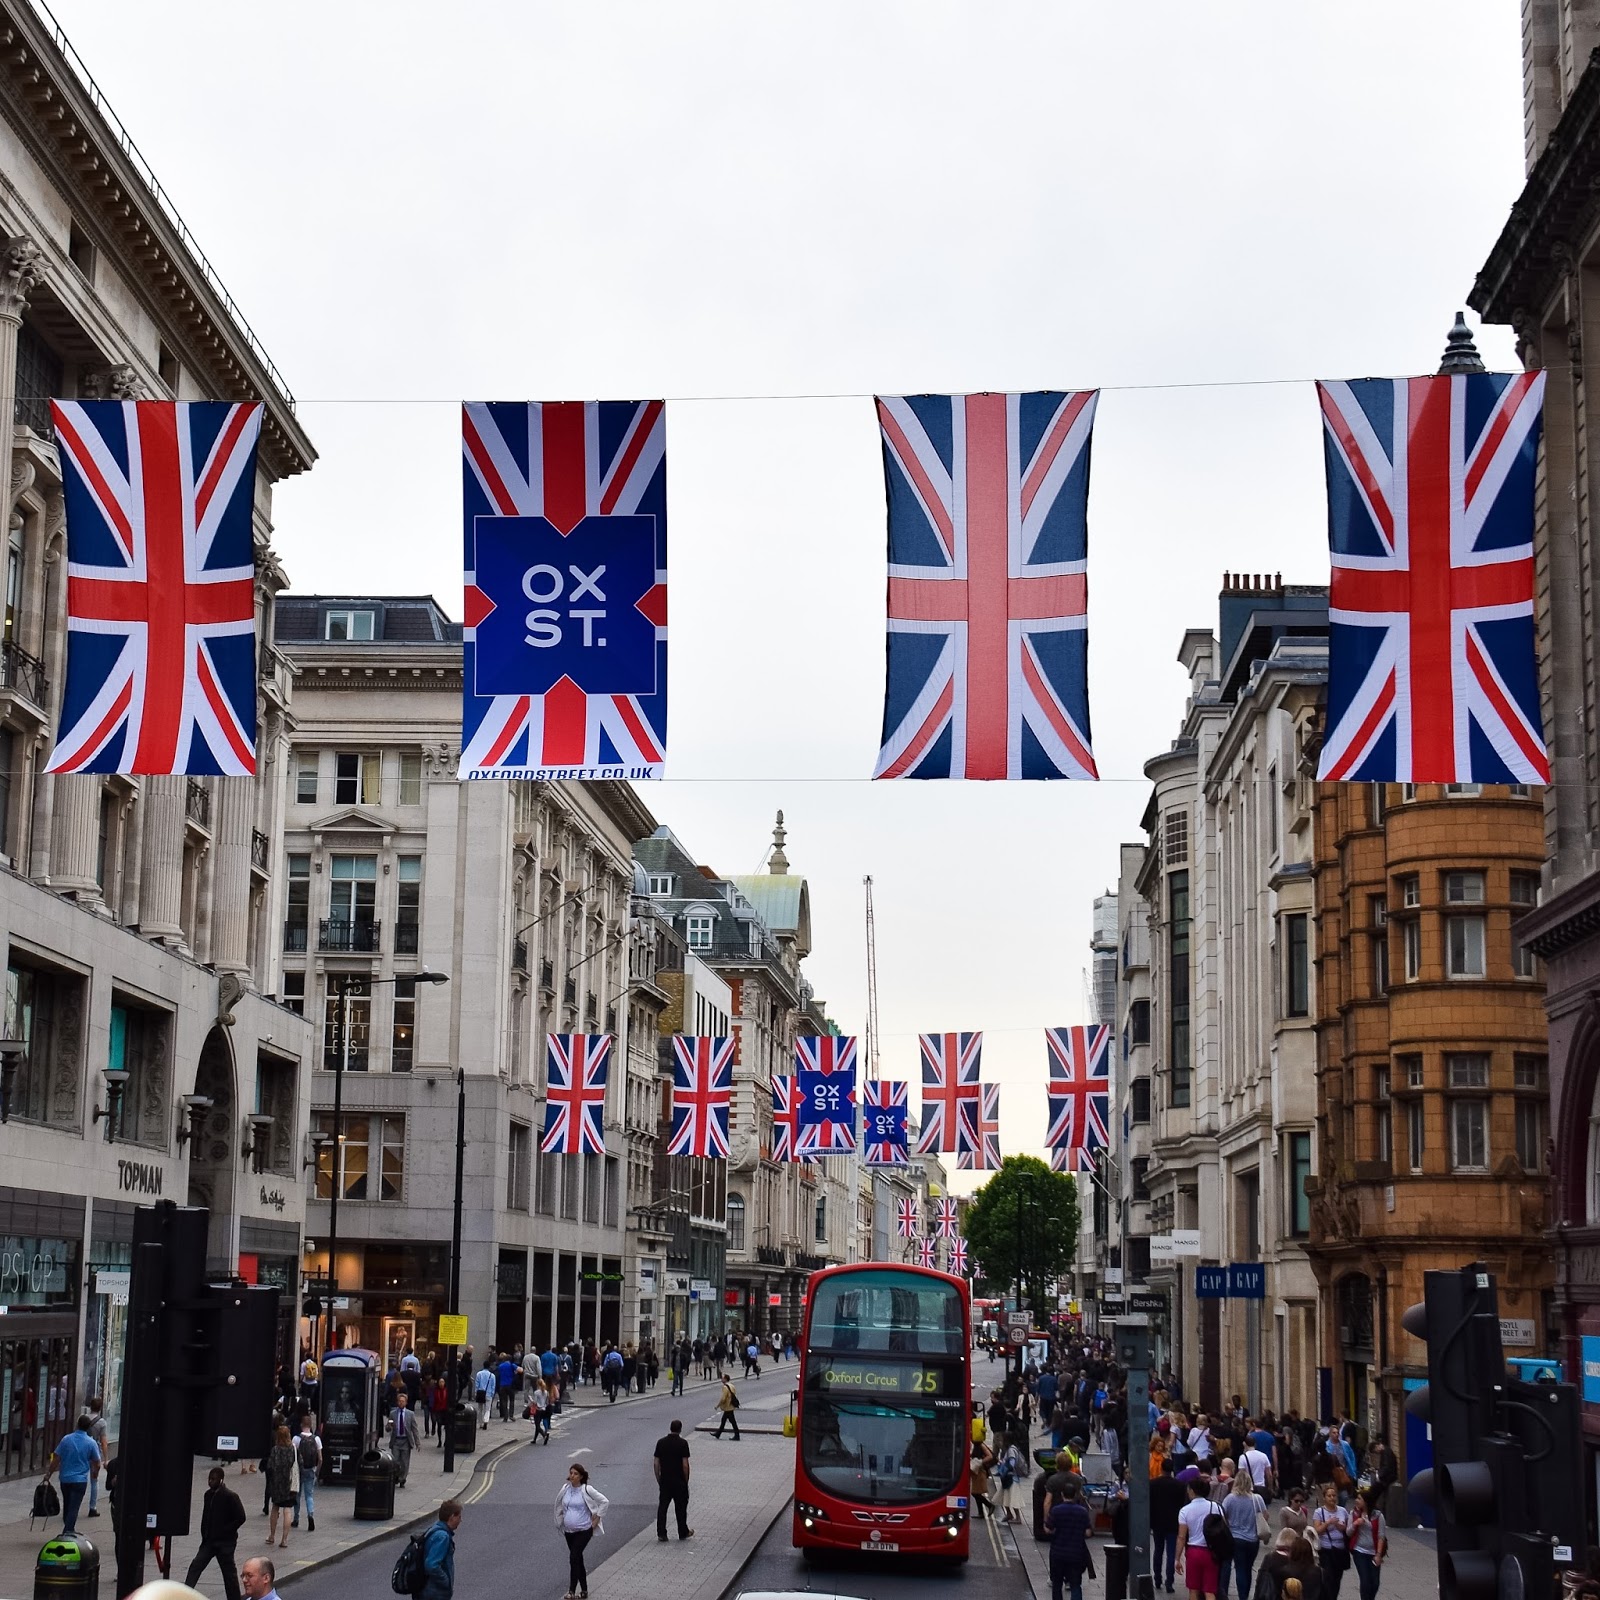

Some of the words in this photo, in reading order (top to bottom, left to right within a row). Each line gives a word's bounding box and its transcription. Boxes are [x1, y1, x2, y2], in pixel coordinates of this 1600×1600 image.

[522, 564, 606, 603] OX
[524, 609, 607, 648] ST.
[468, 767, 654, 780] OXFORDSTREET.CO.UK
[813, 1084, 840, 1097] OX
[814, 1098, 840, 1111] ST.
[876, 1115, 895, 1125] OX
[118, 1159, 163, 1196] TOPMAN
[0, 1252, 53, 1293] PSHOP
[1201, 1275, 1221, 1290] GAP
[1236, 1272, 1259, 1289] GAP
[1133, 1299, 1164, 1308] Bershka
[725, 1309, 738, 1318] OME
[1500, 1321, 1518, 1329] RGYLL
[825, 1370, 862, 1384] Oxford
[865, 1373, 898, 1386] Circus
[912, 1371, 938, 1393] 25
